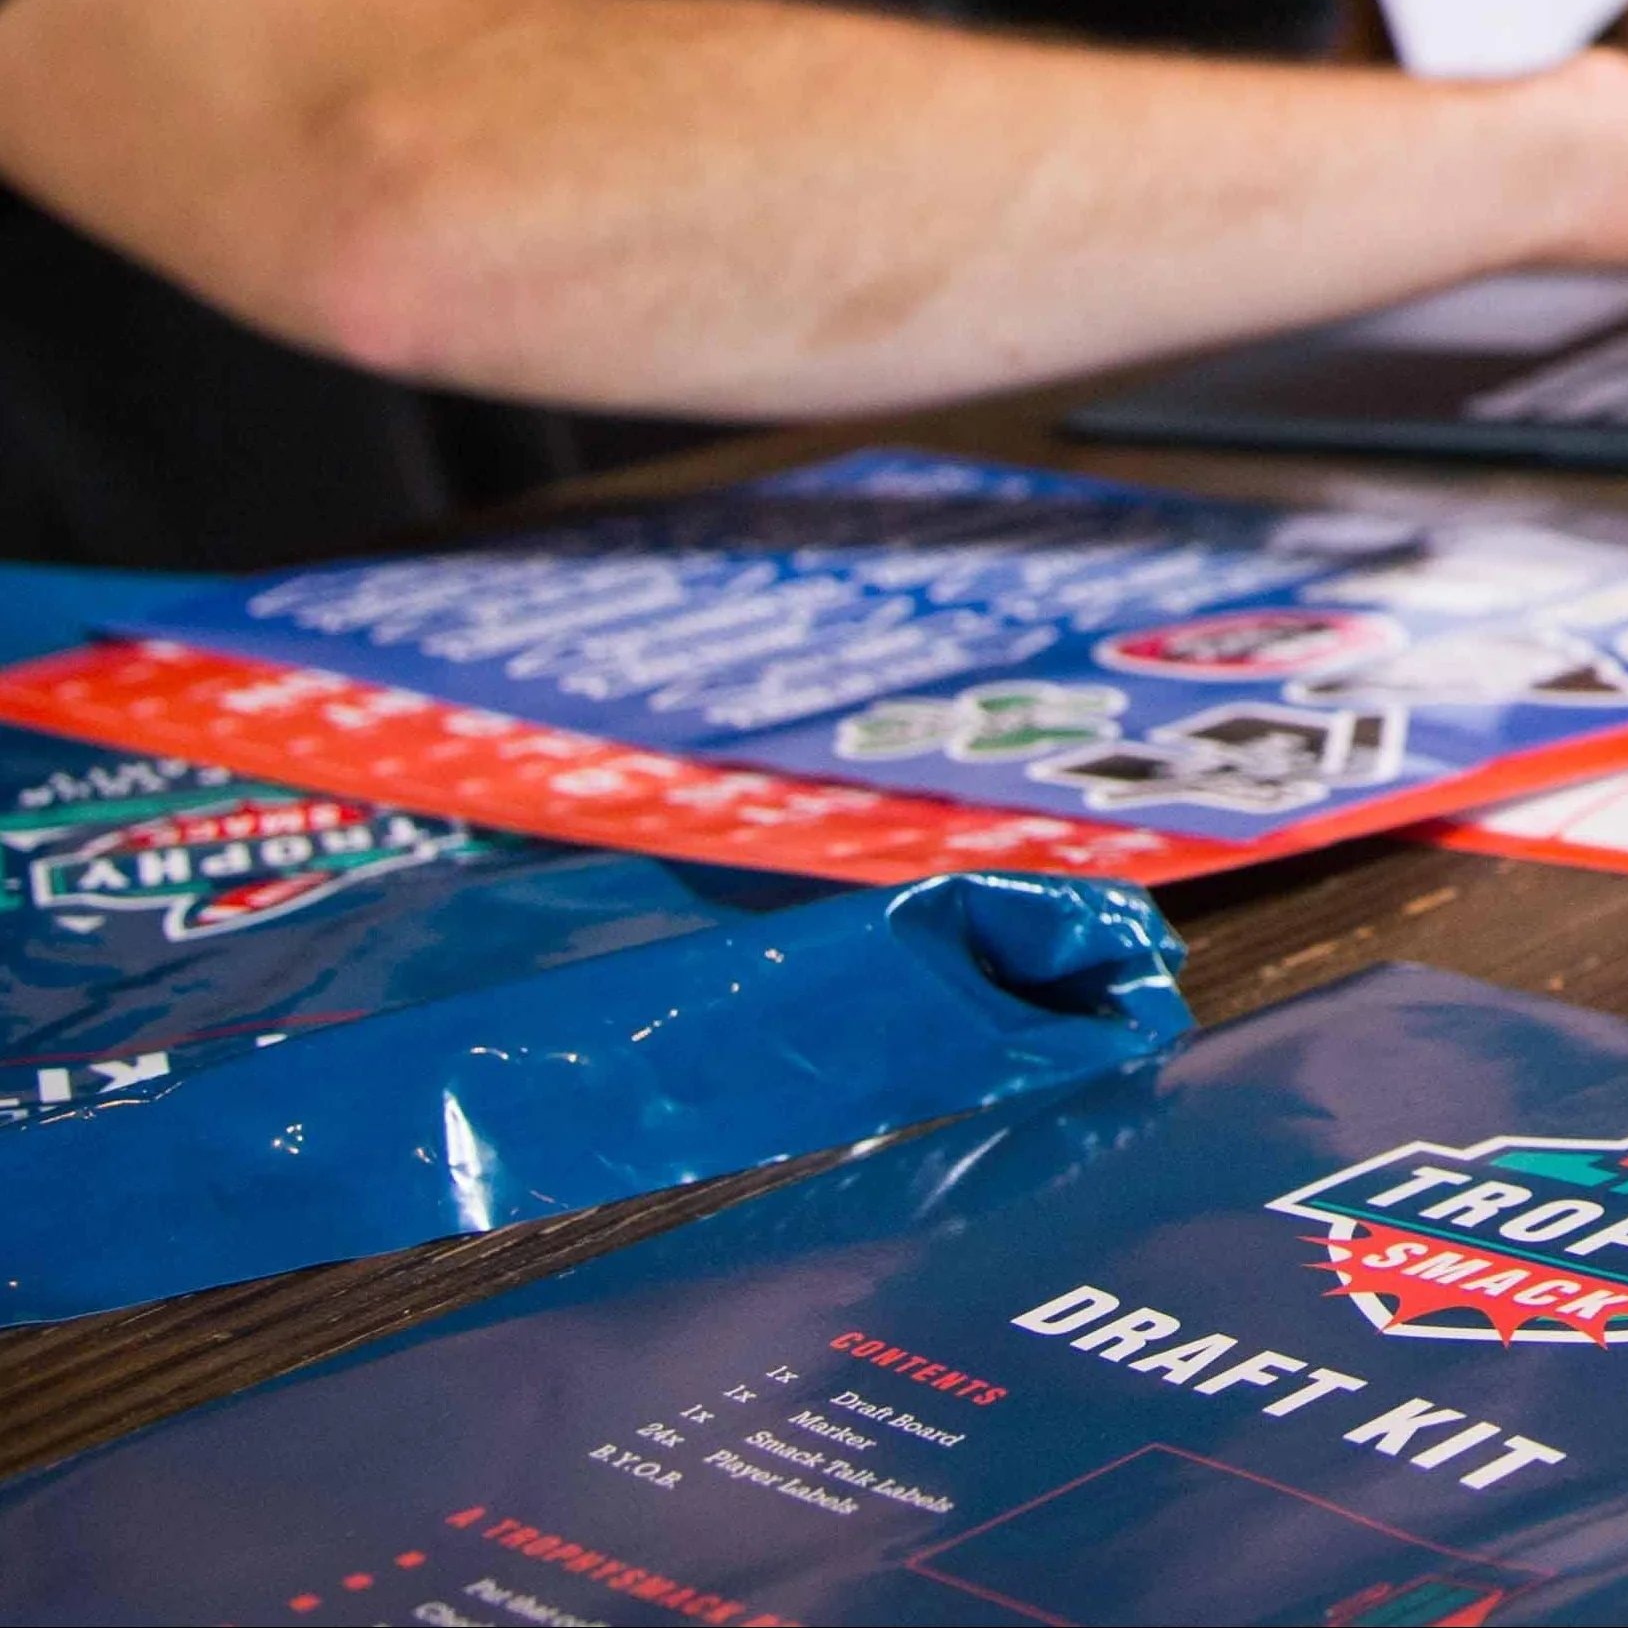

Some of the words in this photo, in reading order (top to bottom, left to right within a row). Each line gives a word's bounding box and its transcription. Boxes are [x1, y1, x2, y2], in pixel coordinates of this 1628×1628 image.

[78, 814, 428, 891] TROPHY
[766, 1365, 799, 1384] 1x
[829, 1390, 894, 1422] Draft
[888, 1414, 966, 1448] Board
[829, 1331, 1008, 1406] CONTENTS
[1010, 1284, 1369, 1417] DRAFT
[1343, 1396, 1568, 1490] KIT
[679, 1403, 715, 1424] 1x
[745, 1430, 825, 1468] Smack
[823, 1458, 877, 1489] Talk
[872, 1478, 954, 1514] Labels
[723, 1383, 758, 1403] 1x
[788, 1410, 877, 1451] Marker
[635, 1422, 685, 1448] 24x
[703, 1448, 785, 1485] Player
[777, 1478, 860, 1515] Labels
